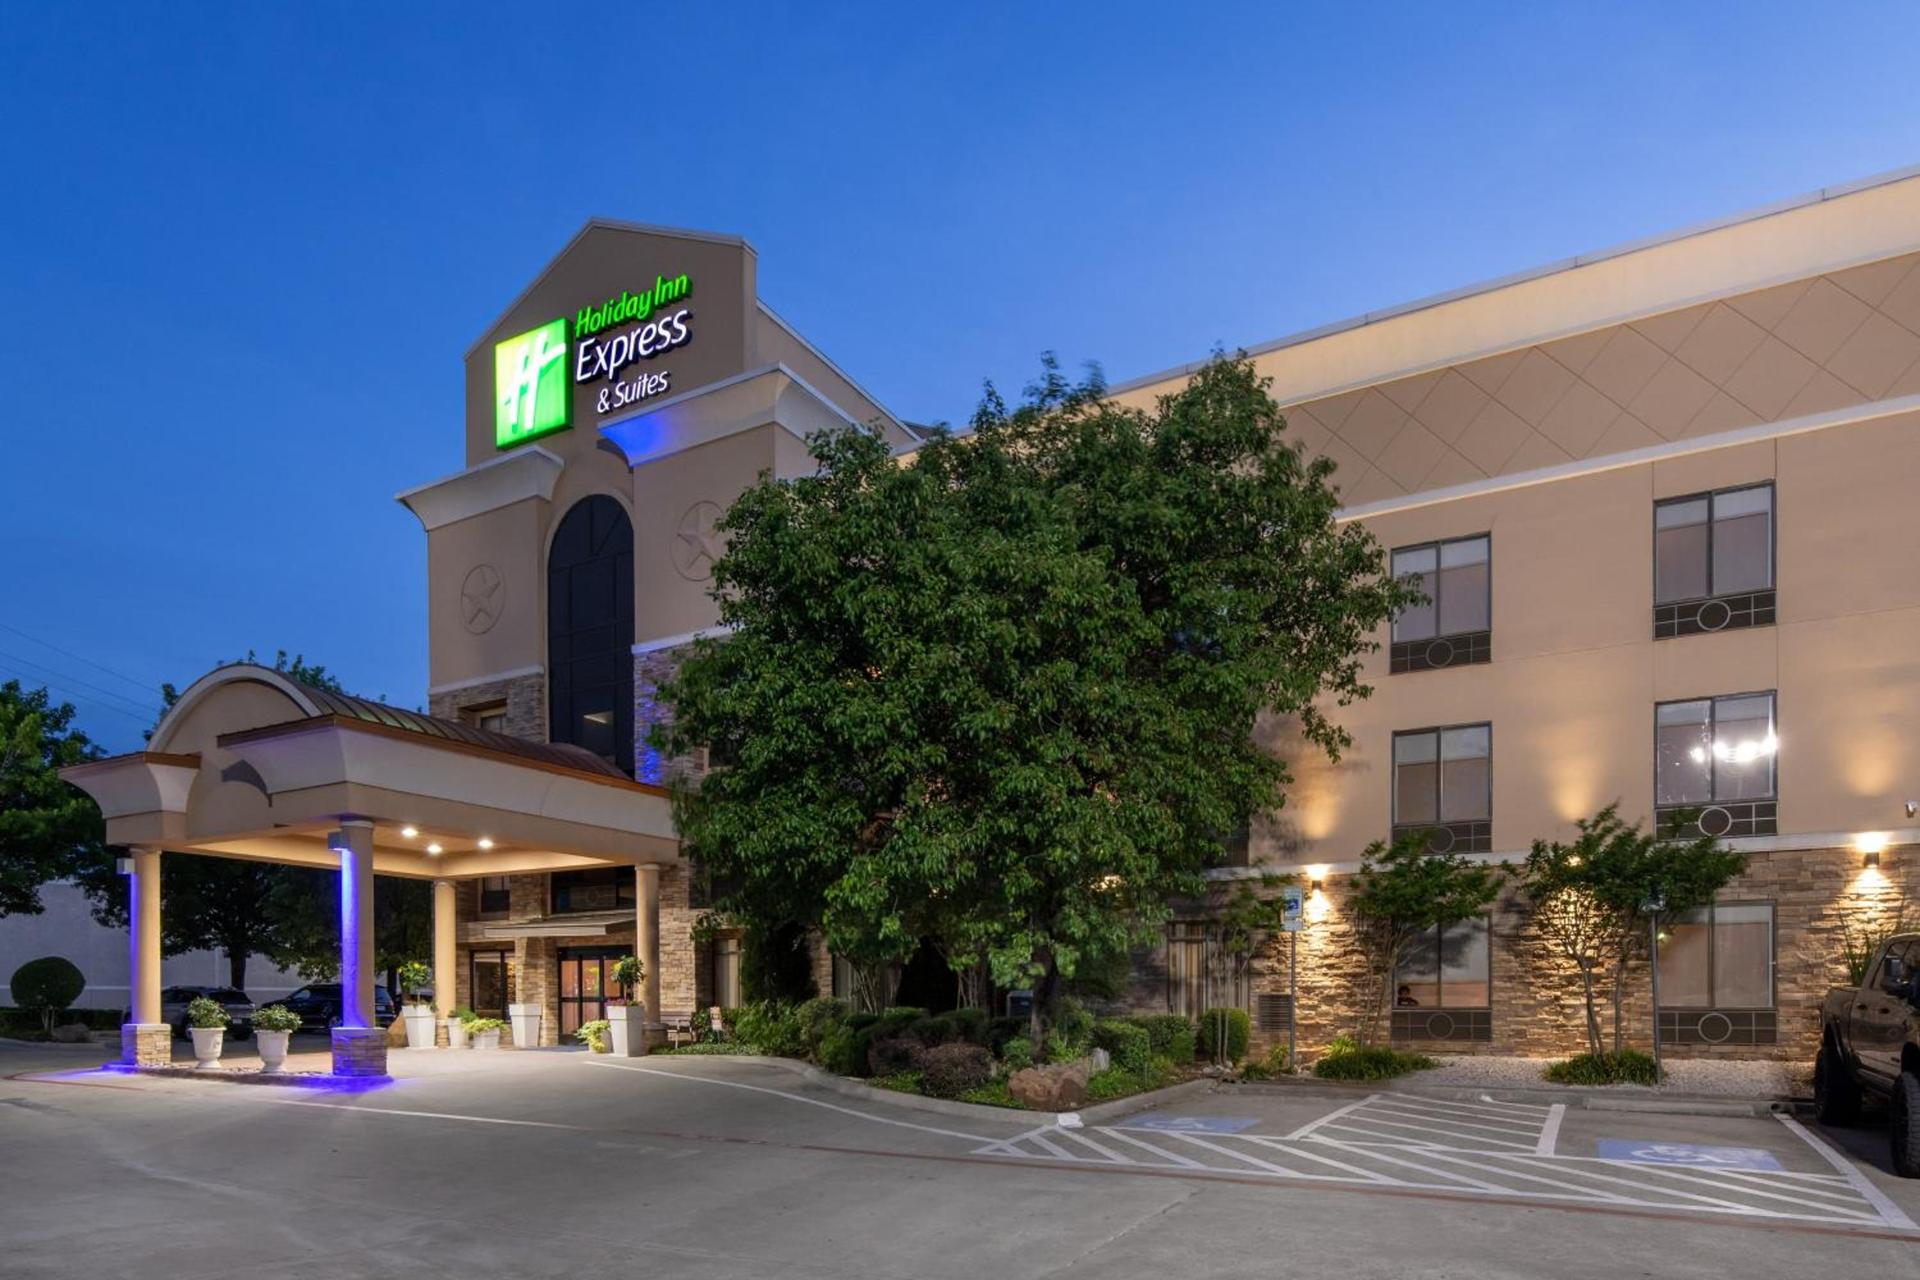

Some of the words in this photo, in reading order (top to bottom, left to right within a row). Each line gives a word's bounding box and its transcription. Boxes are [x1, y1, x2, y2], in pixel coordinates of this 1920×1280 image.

[576, 290, 652, 338] Holiday
[654, 274, 688, 307] Inn
[576, 309, 688, 382] Express
[597, 387, 610, 414] &
[613, 371, 669, 408] Suites
